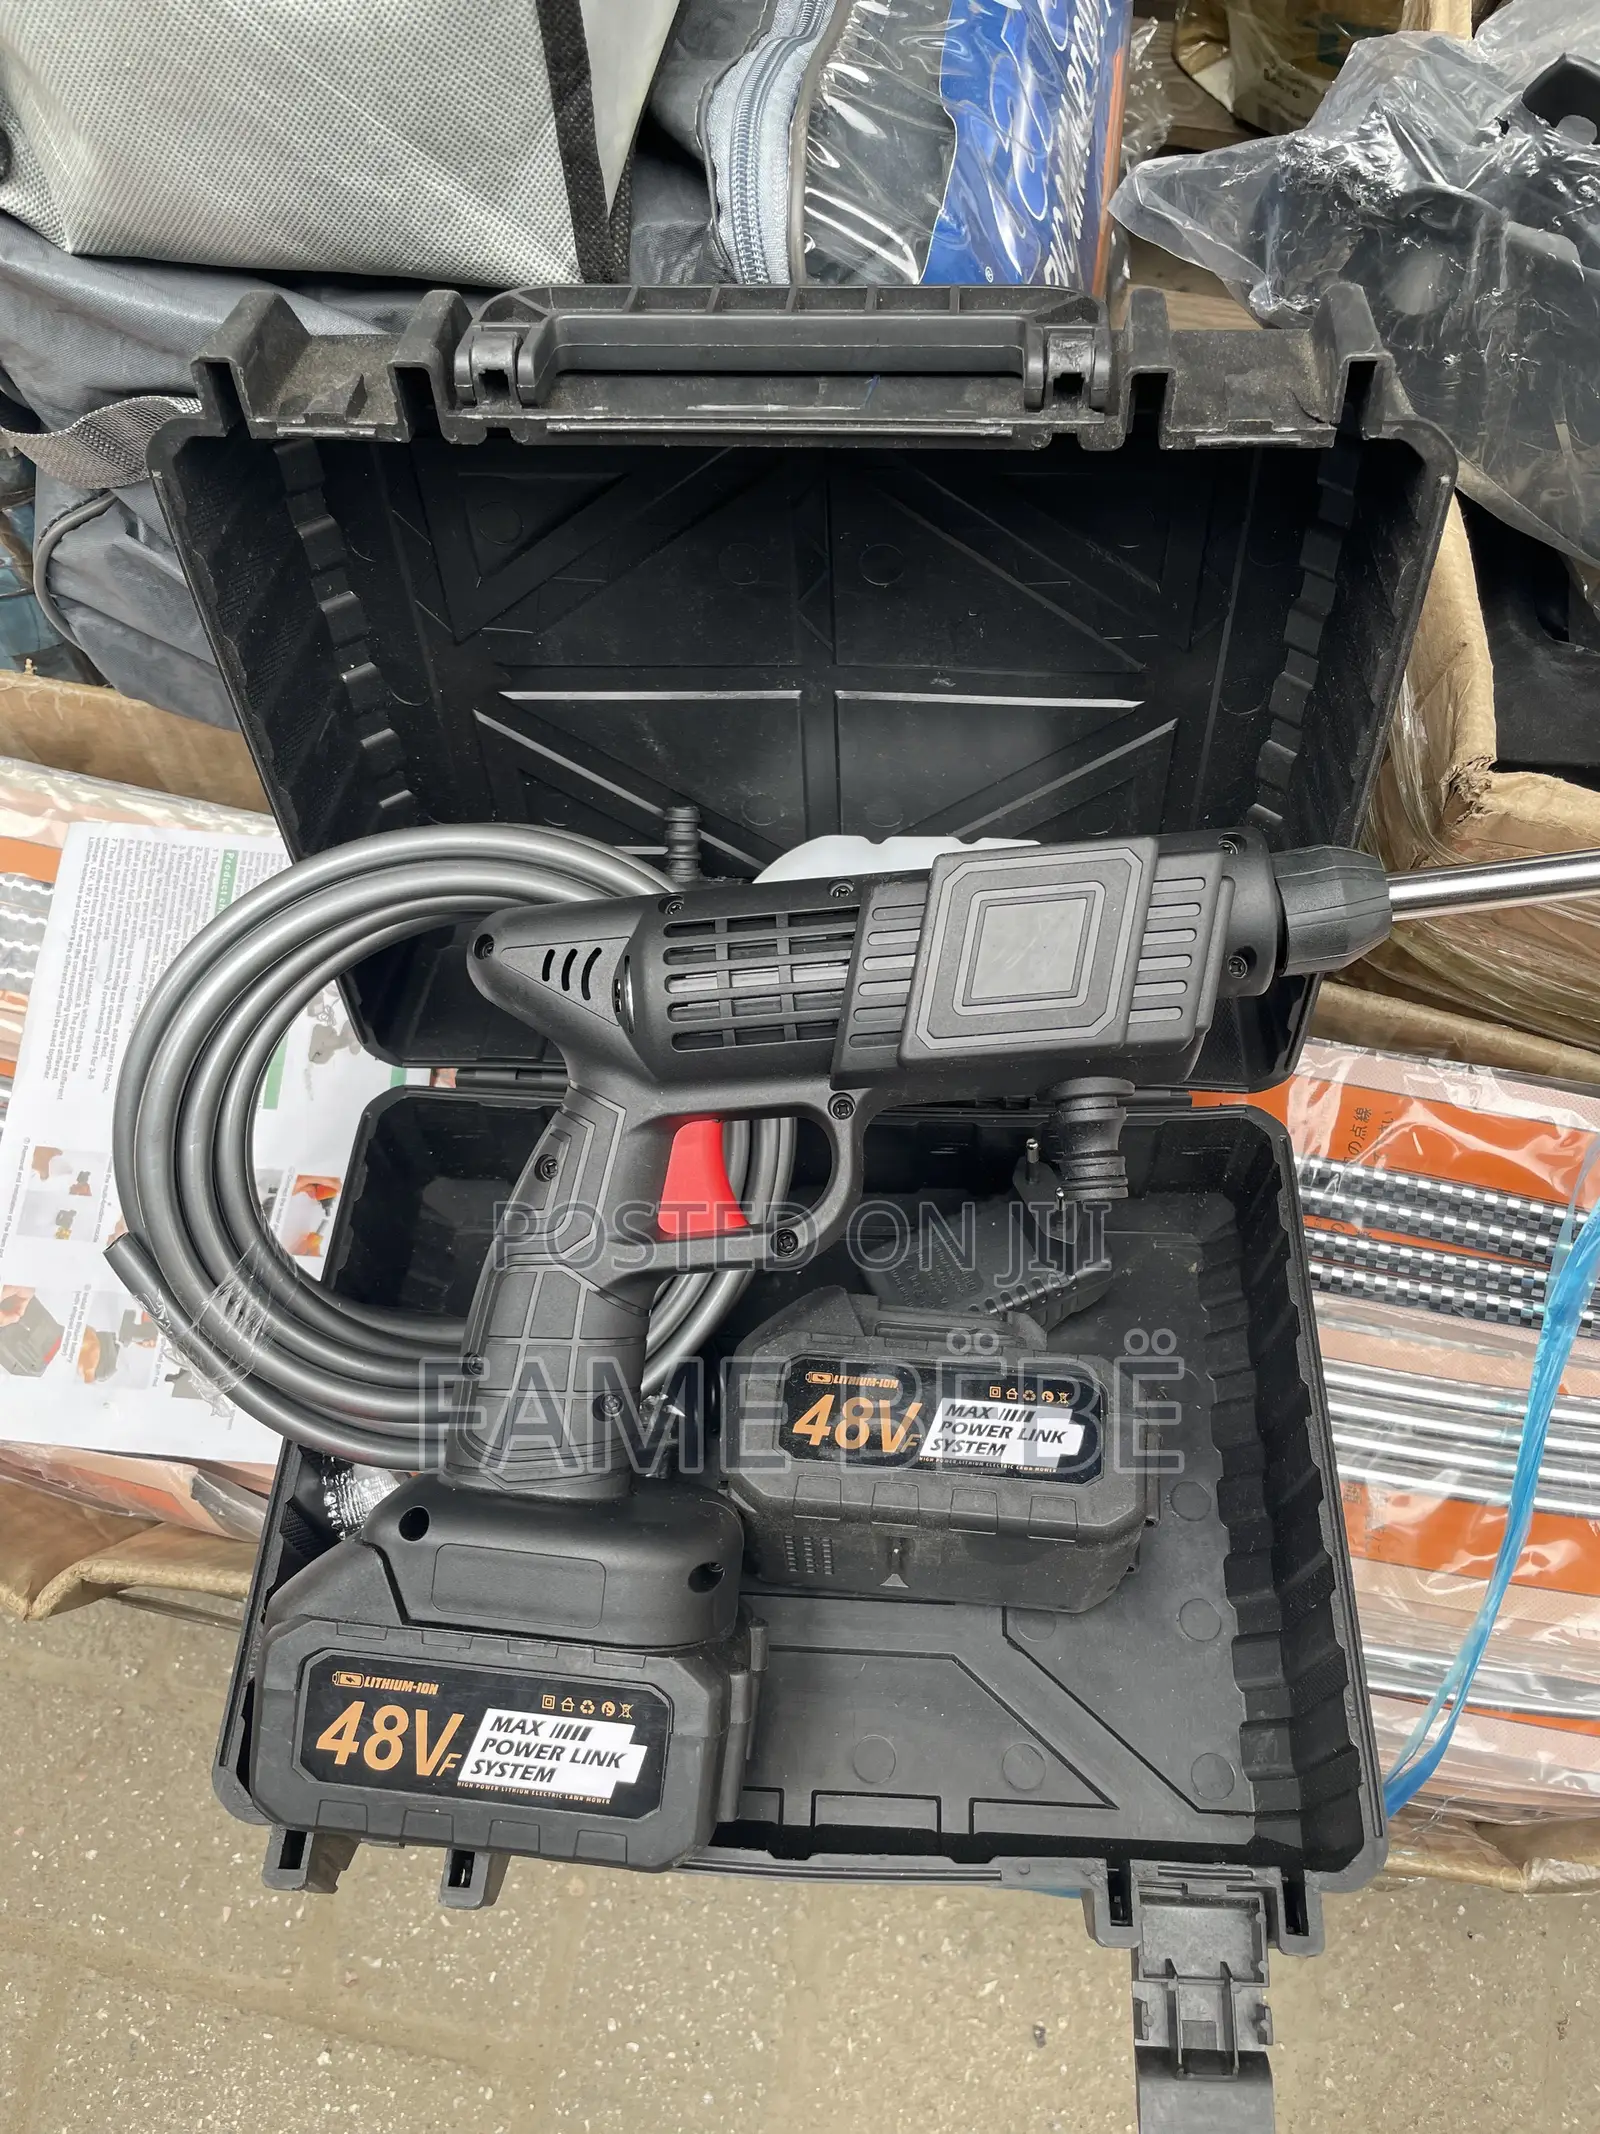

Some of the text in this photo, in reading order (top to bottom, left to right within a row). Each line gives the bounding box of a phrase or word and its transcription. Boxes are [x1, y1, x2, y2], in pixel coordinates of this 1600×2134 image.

[108, 846, 116, 859] The
[220, 851, 233, 895] Product
[832, 1374, 899, 1390] LITHIUM-ION
[945, 1402, 990, 1421] MAX
[937, 1420, 1068, 1445] POWER LINK
[930, 1437, 1007, 1457] SYSTEM
[364, 1674, 439, 1695] LITHIUM-ION
[490, 1715, 543, 1738] MAX
[479, 1738, 626, 1769] POWER LINK
[470, 1759, 557, 1783] SYSTEM
[475, 1783, 498, 1791] POWER
[501, 1786, 530, 1795] LITHIUM
[531, 1790, 563, 1799] ELECTRIC
